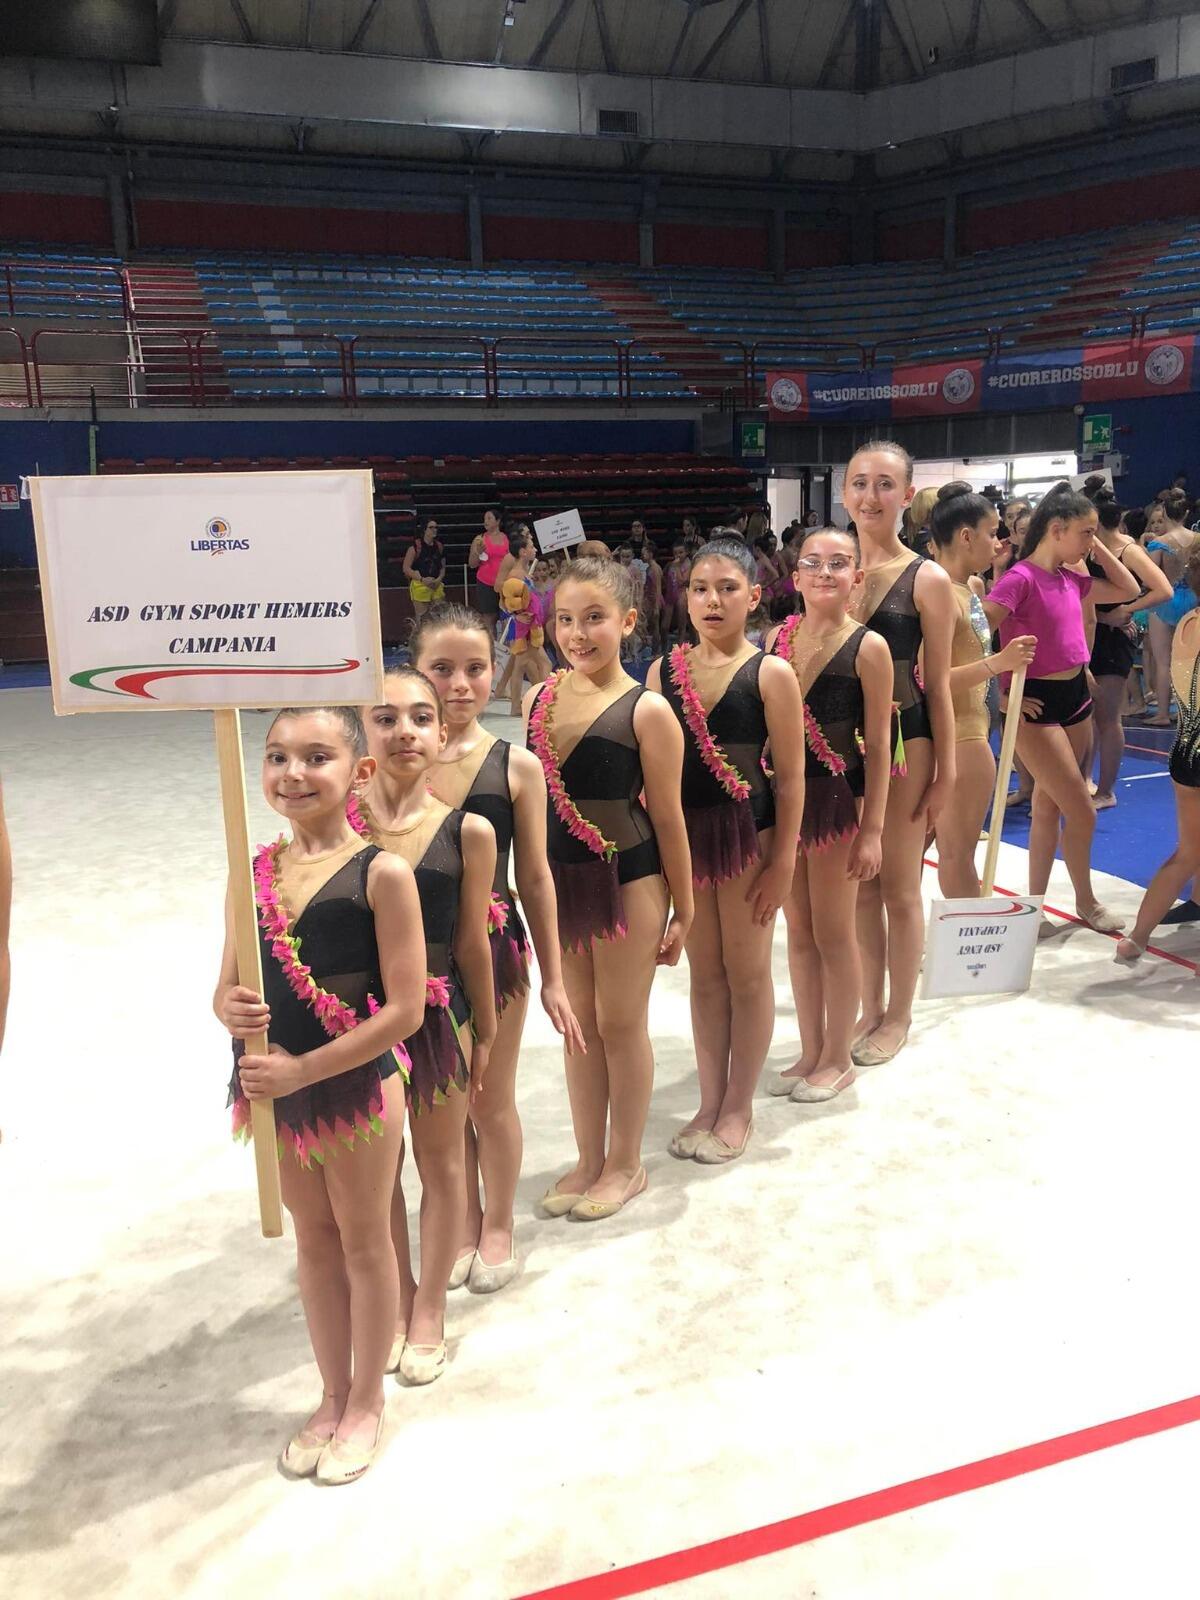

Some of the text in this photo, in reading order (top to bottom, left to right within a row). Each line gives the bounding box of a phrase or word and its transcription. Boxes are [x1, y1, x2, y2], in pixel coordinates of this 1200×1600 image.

[988, 361, 1139, 388] #CUOREROSSOBLU
[812, 382, 938, 402] #CUOREROSSOBLU
[191, 539, 250, 551] LIBERTAS
[87, 601, 352, 622] ASD GYM SPORT HEMERS
[169, 636, 276, 654] CAMPANIA
[959, 926, 1007, 936] CAMPANIA
[984, 944, 1003, 953] ASD
